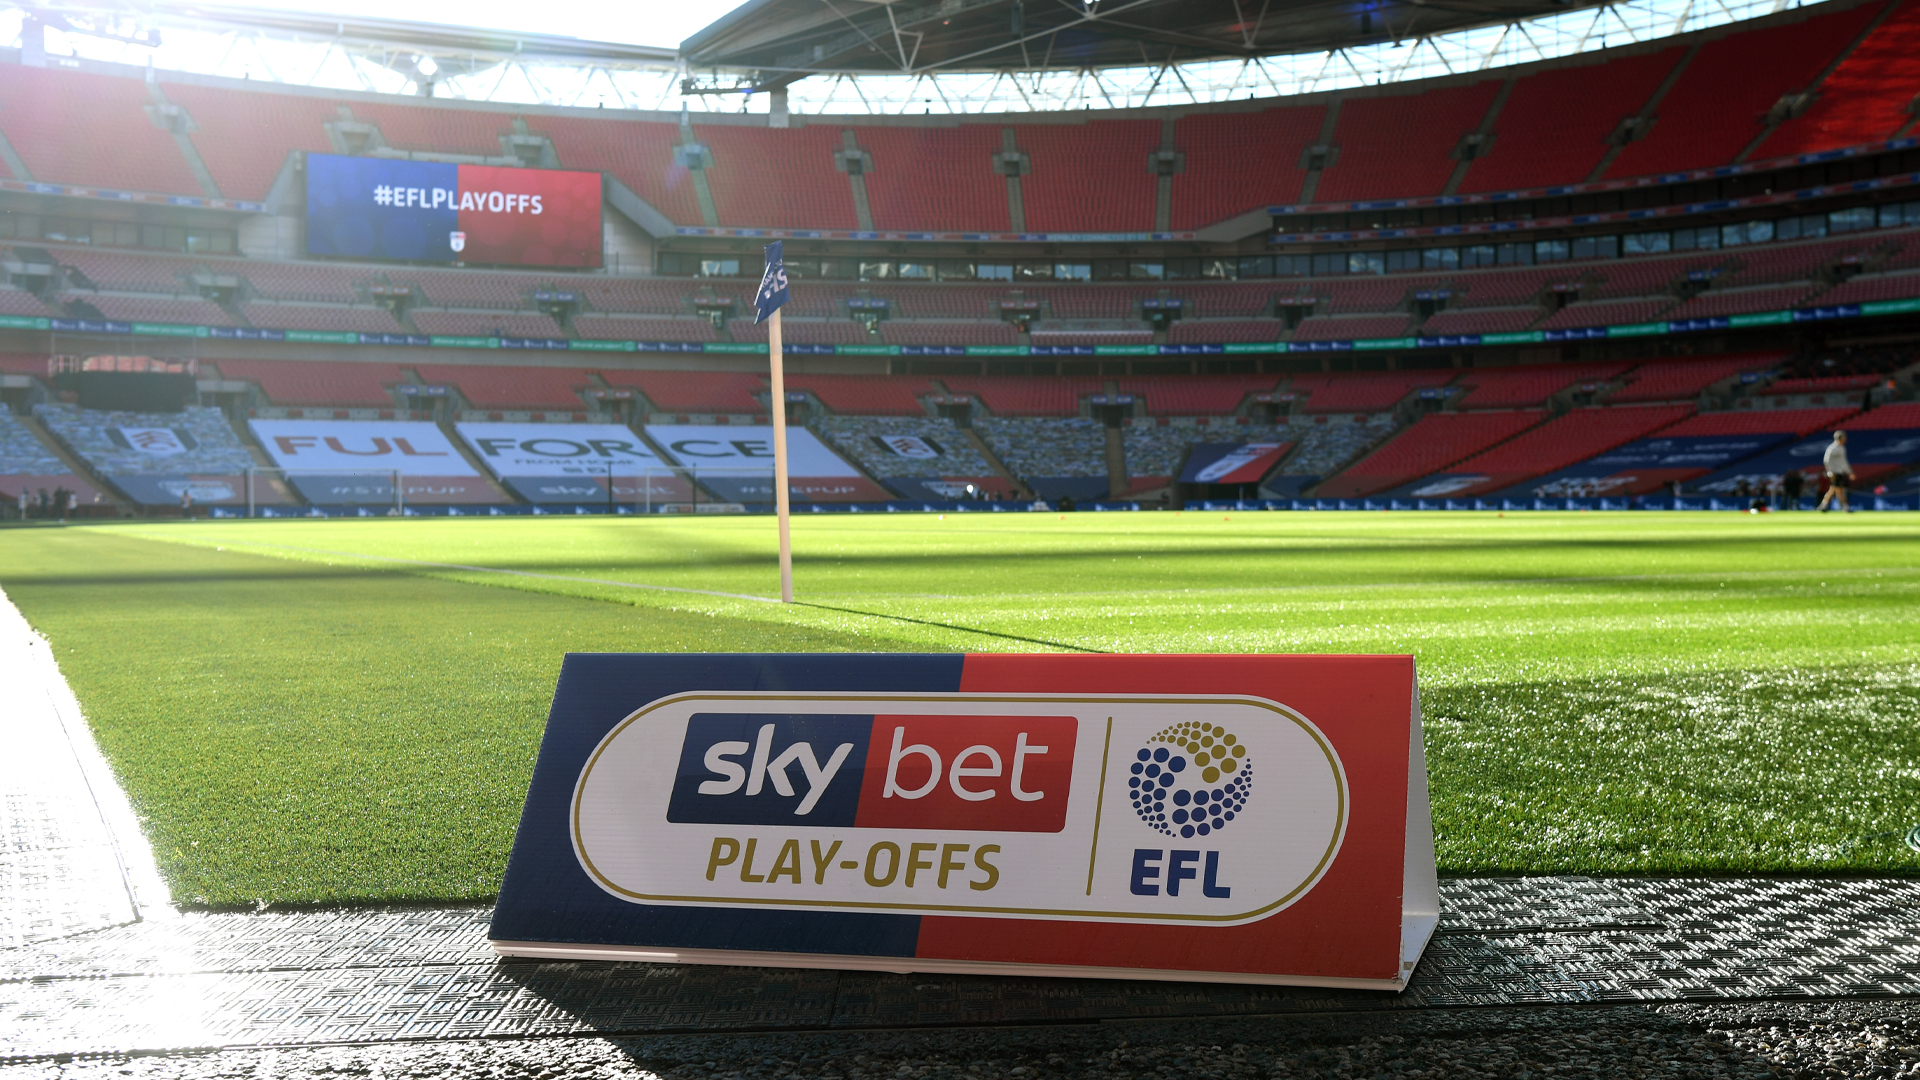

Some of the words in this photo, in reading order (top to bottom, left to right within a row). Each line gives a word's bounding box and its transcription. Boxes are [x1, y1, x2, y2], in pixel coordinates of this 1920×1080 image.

[373, 185, 543, 215] #EFLPLAYOFFS
[273, 436, 449, 456] FUL
[739, 486, 856, 494] #SEPUP
[698, 723, 854, 815] sky
[882, 726, 1049, 802] bet
[705, 837, 1001, 891] PLAY-OFFS
[1130, 849, 1231, 899] EFL
